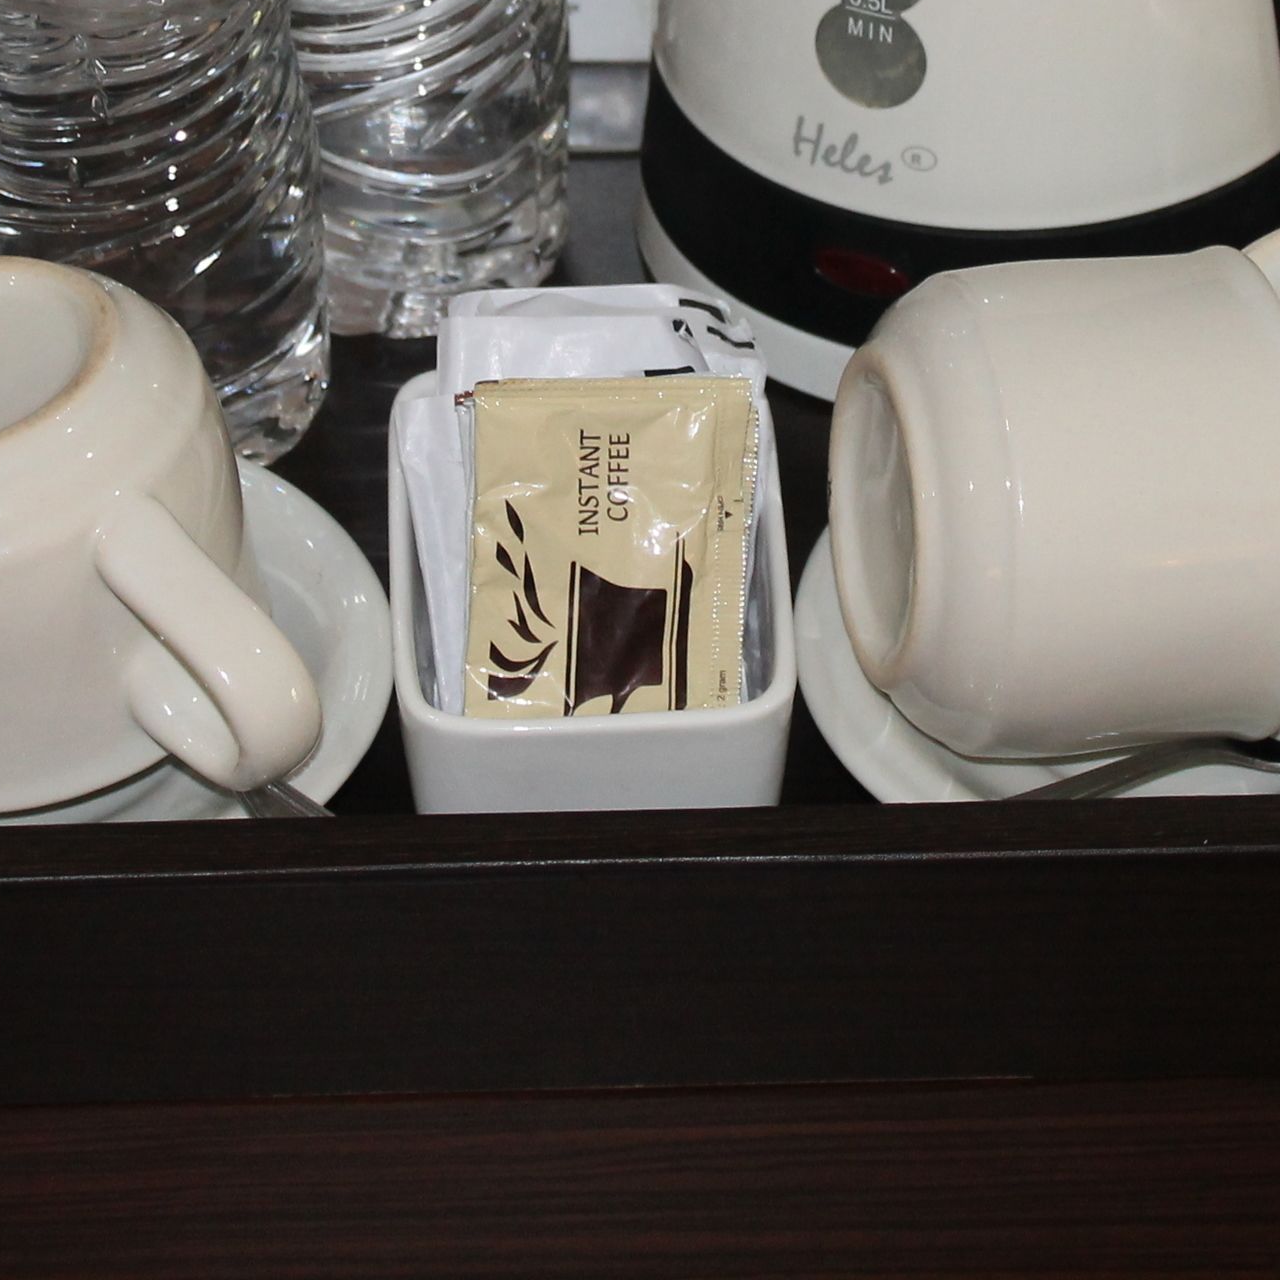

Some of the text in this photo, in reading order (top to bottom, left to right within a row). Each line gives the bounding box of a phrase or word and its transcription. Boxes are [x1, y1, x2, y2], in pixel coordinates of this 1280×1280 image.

[848, 17, 894, 44] MIN
[578, 428, 601, 535] INSTANT
[607, 432, 630, 522] COFFEE
